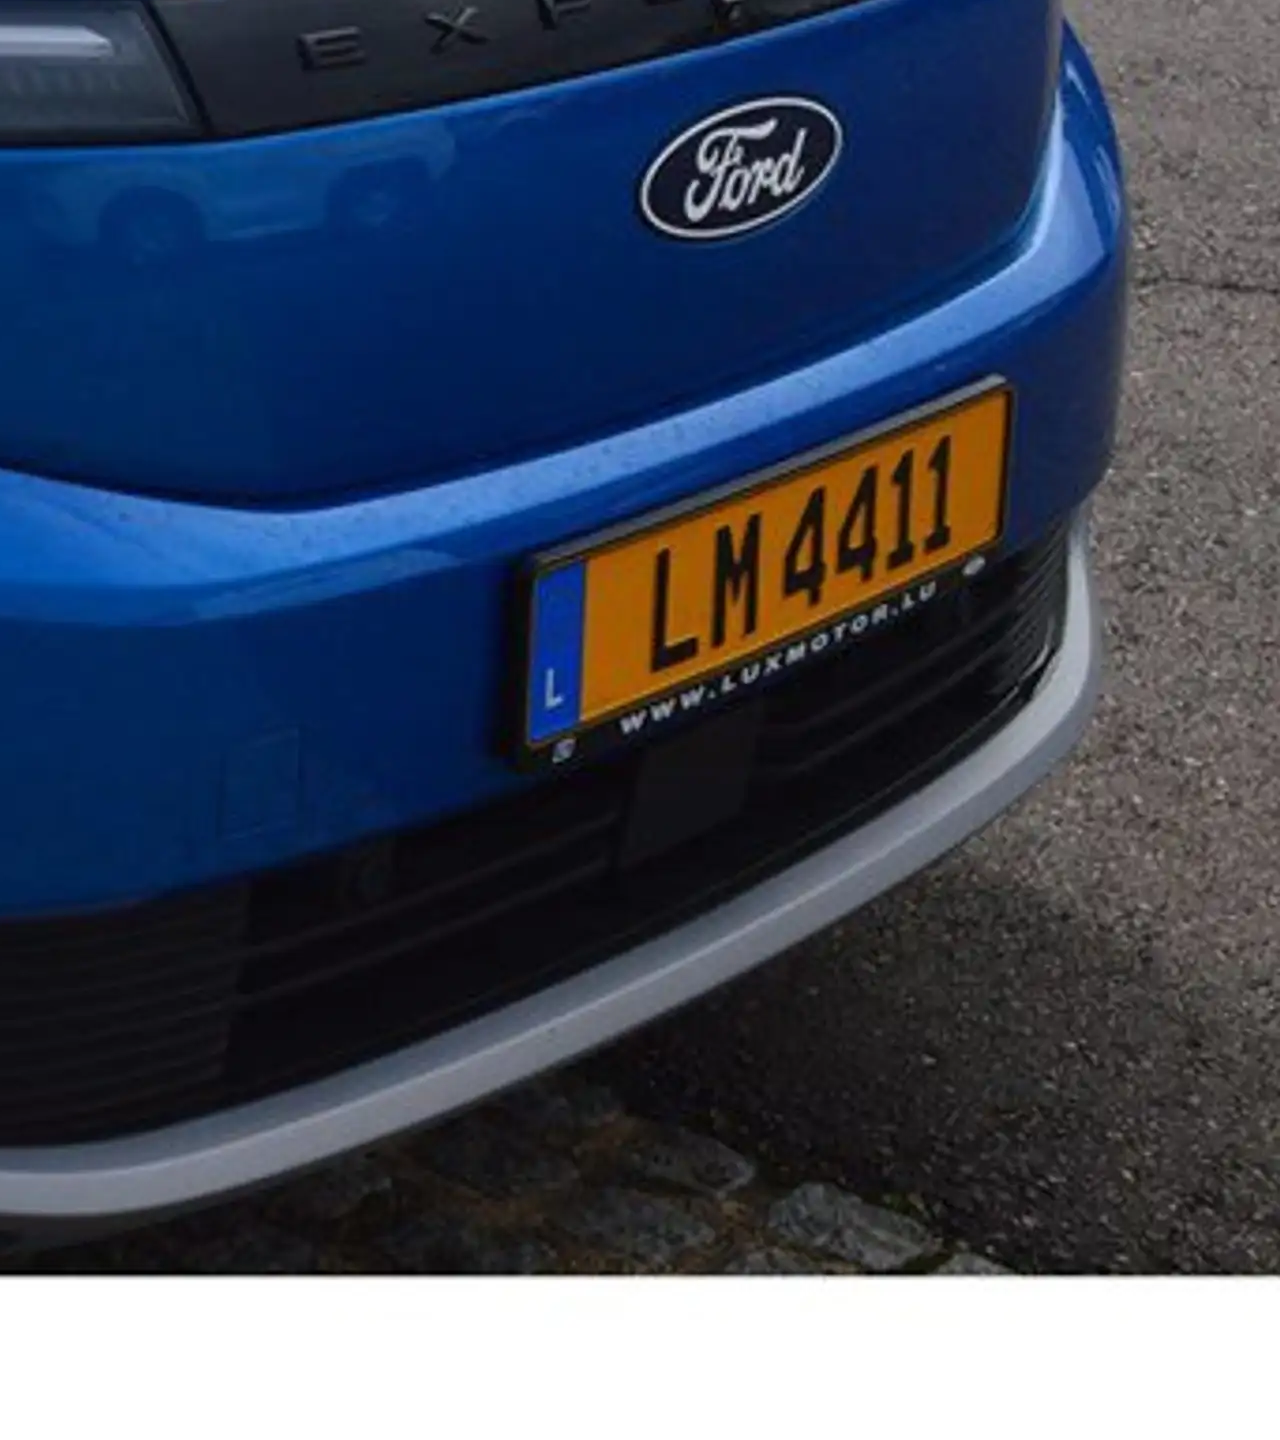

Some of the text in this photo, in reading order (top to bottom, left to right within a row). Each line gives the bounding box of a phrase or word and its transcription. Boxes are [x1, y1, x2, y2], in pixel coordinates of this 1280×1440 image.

[683, 117, 807, 223] Ford
[783, 434, 953, 607] 4411
[545, 666, 565, 709] L
[619, 580, 938, 736] WWW.LUXMOTOR.LU
